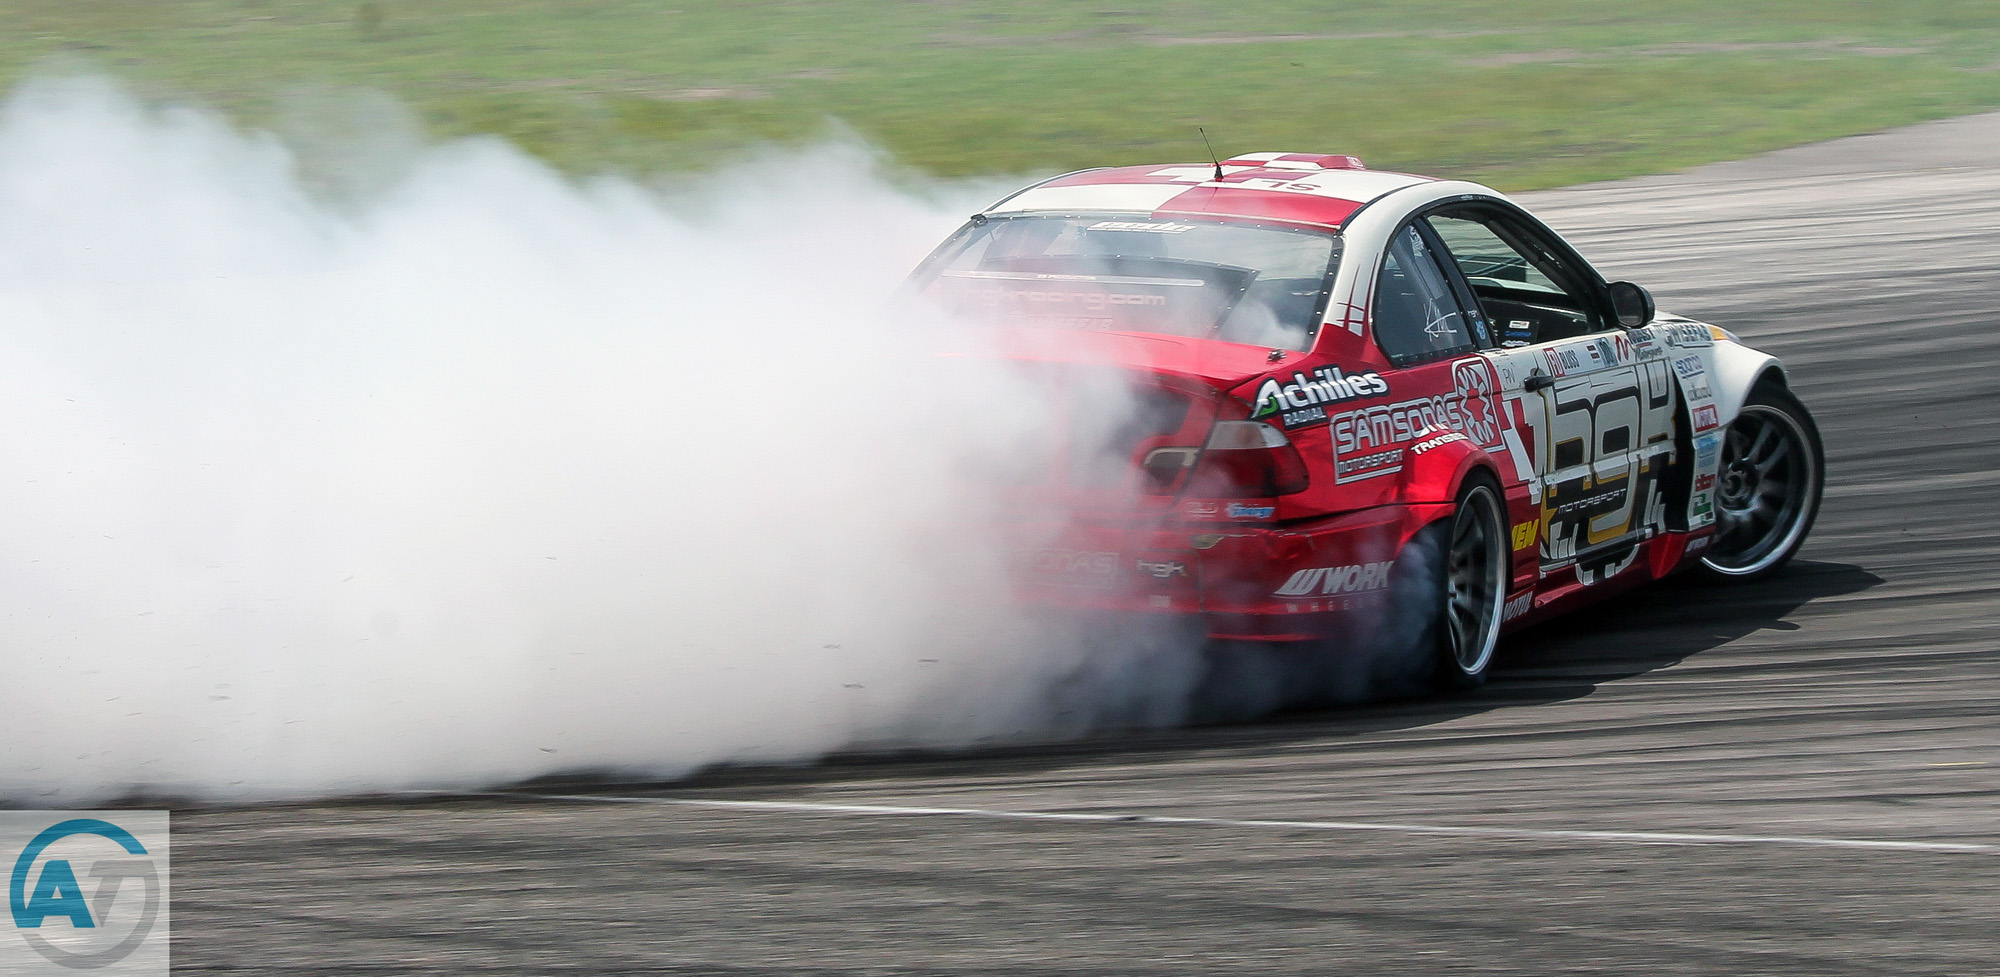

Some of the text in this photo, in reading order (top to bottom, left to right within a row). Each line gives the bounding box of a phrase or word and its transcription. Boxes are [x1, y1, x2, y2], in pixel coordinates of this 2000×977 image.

[1252, 365, 1389, 419] Achilles
[1284, 407, 1326, 427] RADIAL
[1336, 396, 1464, 453] SAMSONAS
[1338, 449, 1403, 474] MOTORSPORT
[1558, 488, 1627, 514] MOTORSPORT
[1324, 560, 1396, 596] WORK
